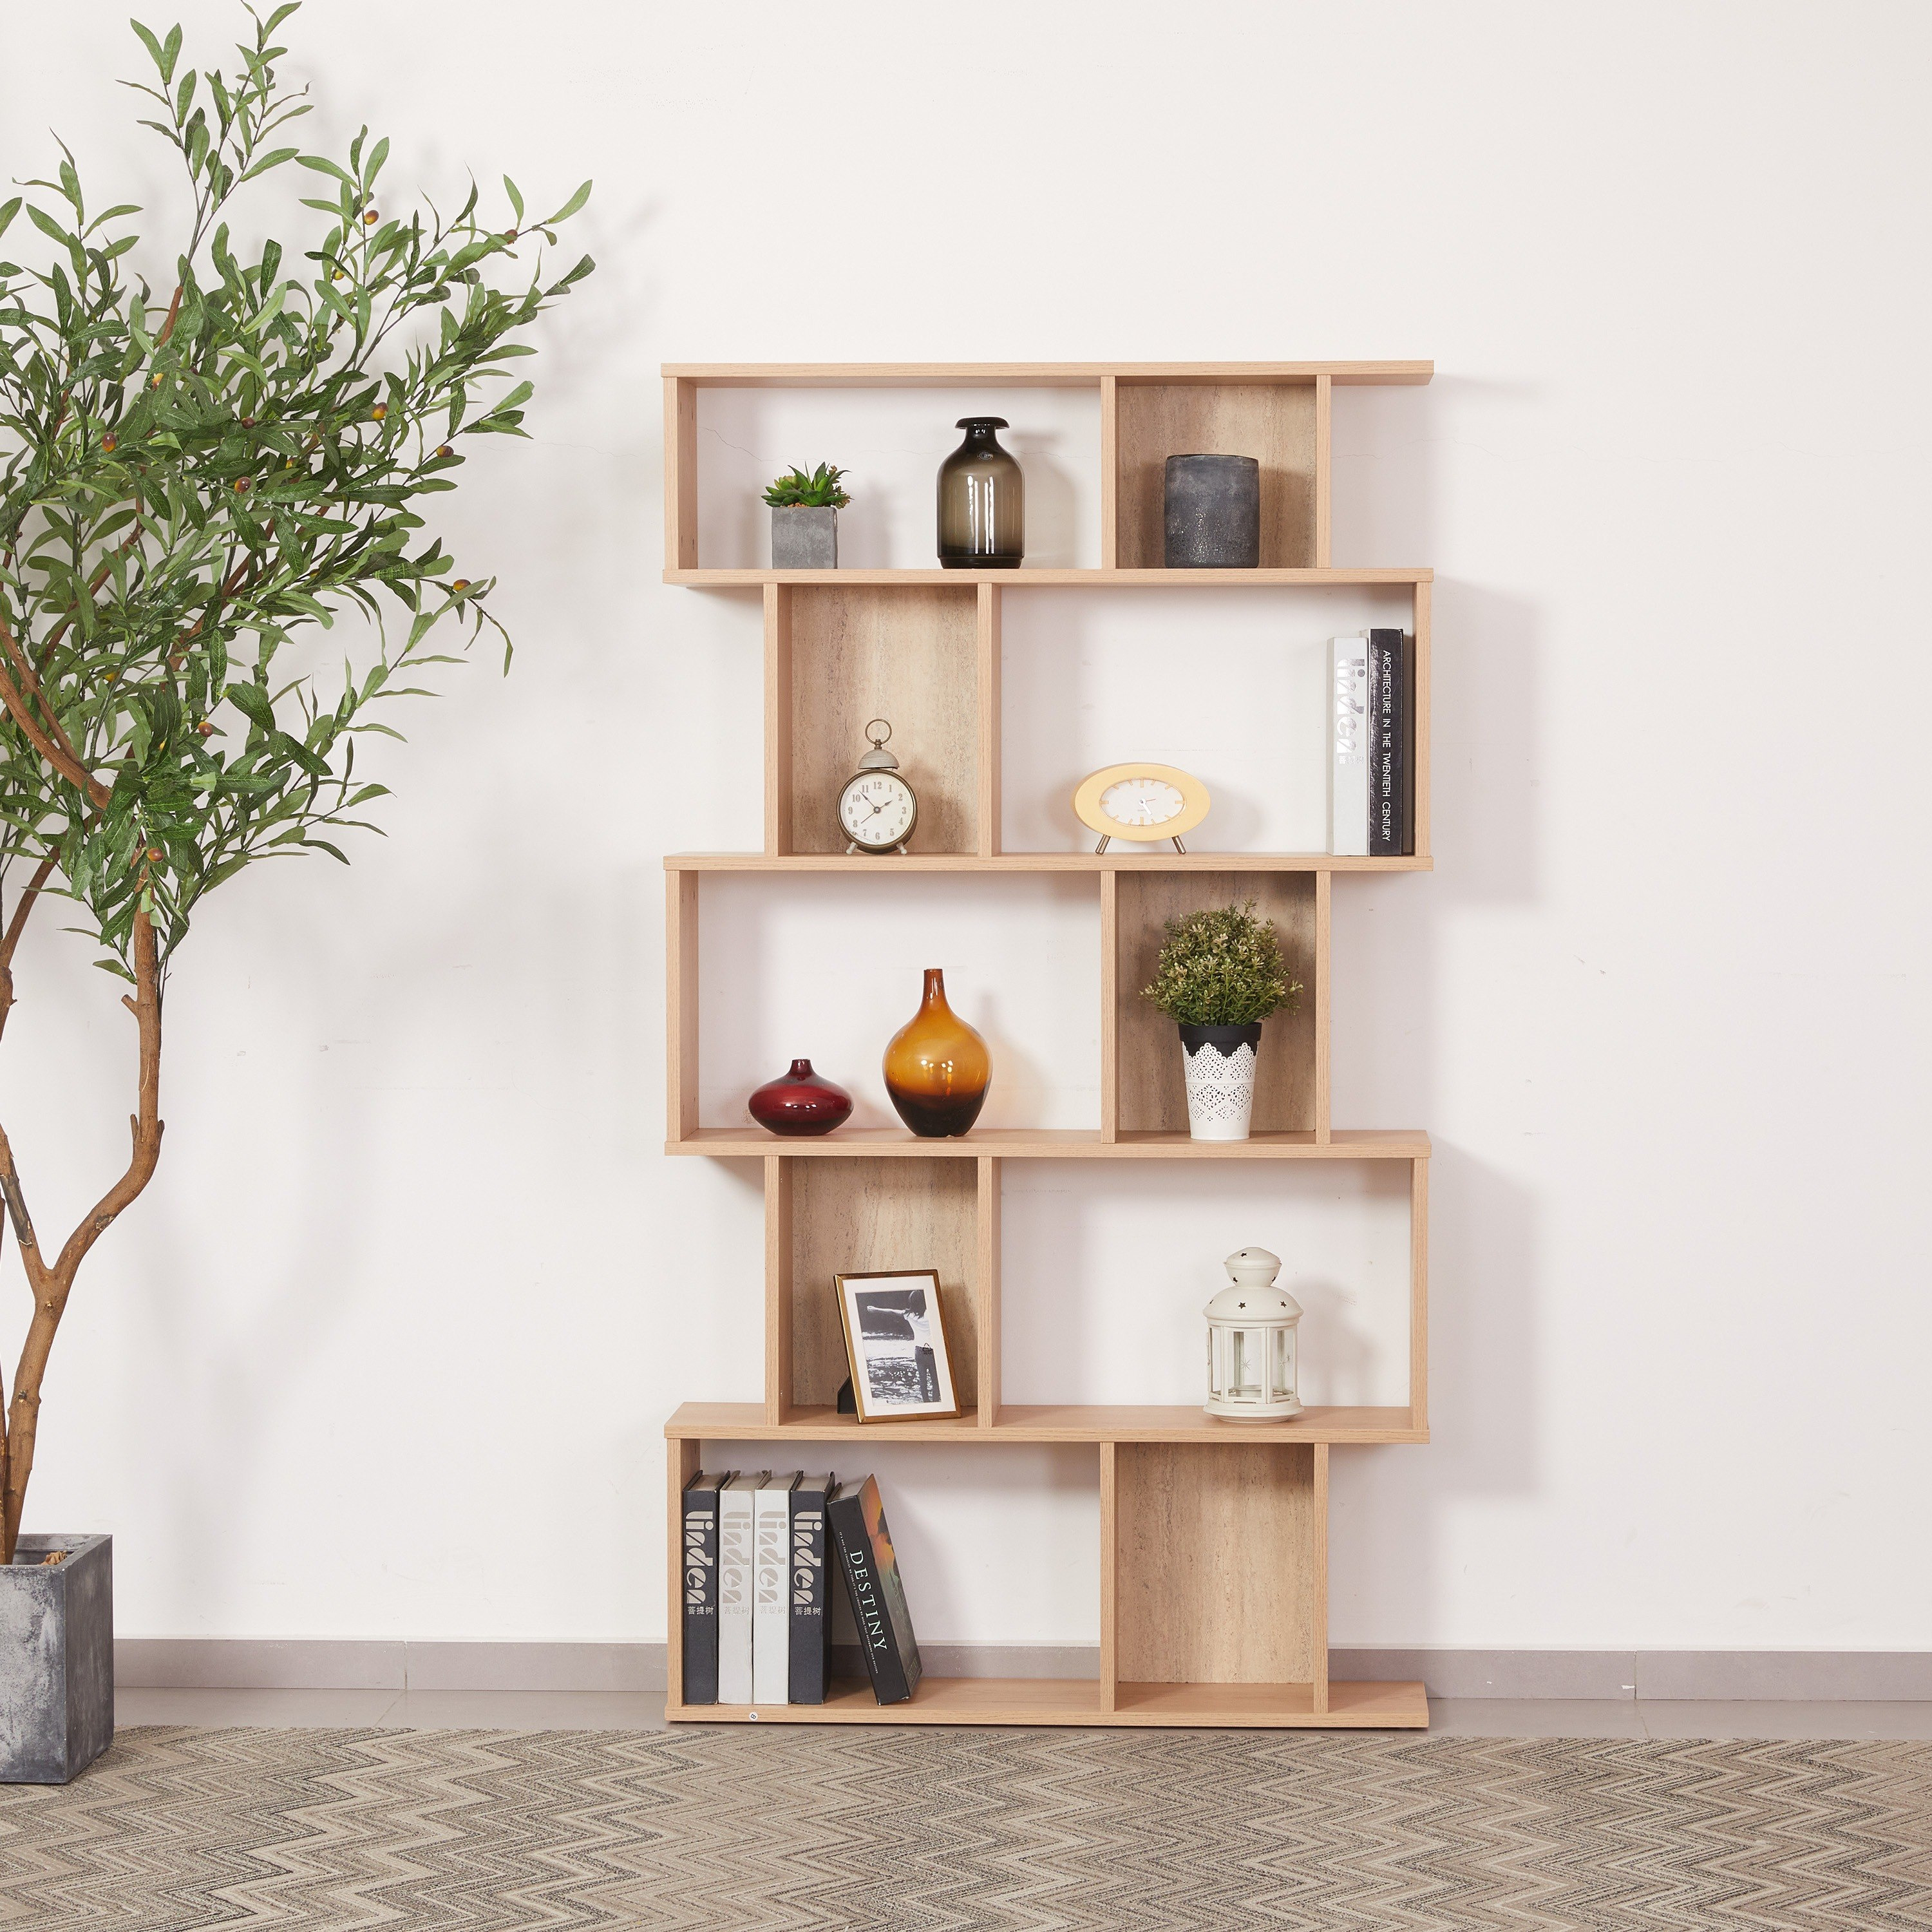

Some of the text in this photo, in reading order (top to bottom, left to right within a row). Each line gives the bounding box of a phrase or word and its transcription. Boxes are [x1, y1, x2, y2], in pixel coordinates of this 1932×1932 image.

[1337, 659, 1365, 753] linden
[1382, 650, 1391, 841] ARCHITECTURE IN THE TWENTIETH CENTURY
[686, 1511, 714, 1604] linden
[723, 1511, 750, 1604] linden
[759, 1511, 786, 1604] linden
[793, 1511, 822, 1604] linden
[849, 1550, 887, 1649] DESTINY
[688, 1606, 714, 1615] 菩提树
[795, 1606, 821, 1615] 菩提树
